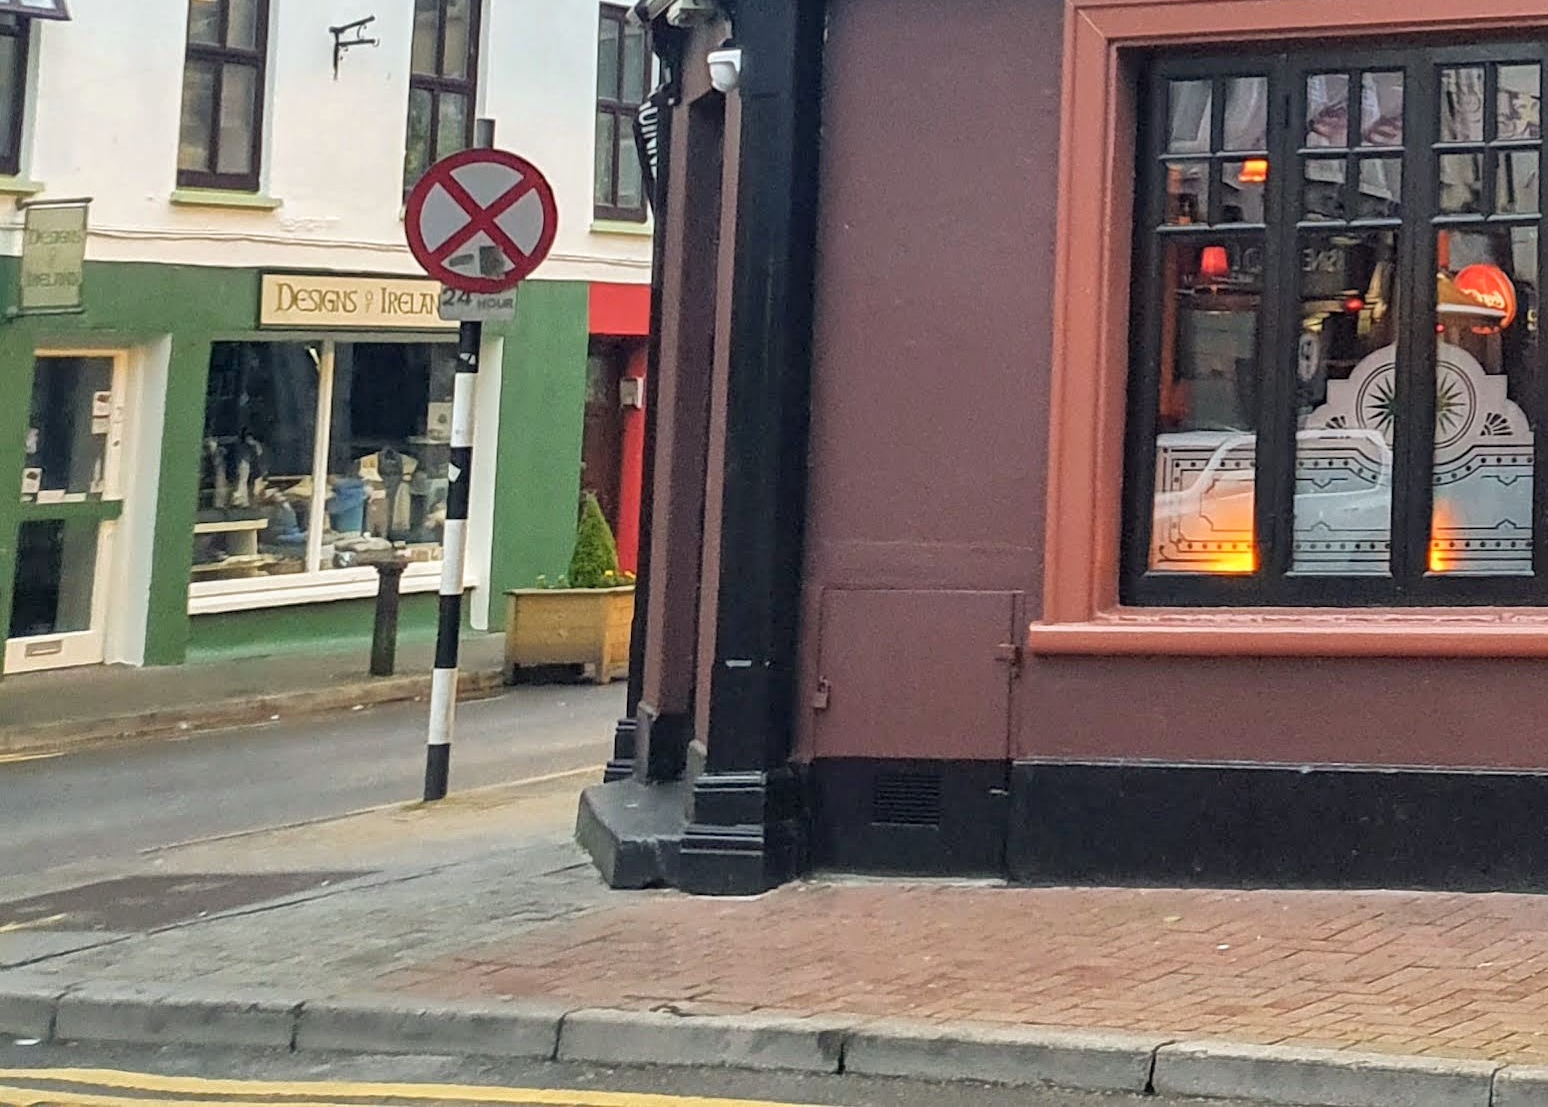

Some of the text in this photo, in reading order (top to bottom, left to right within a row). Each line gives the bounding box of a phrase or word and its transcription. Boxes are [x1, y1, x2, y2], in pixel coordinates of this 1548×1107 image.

[275, 282, 357, 314] DESIGNS
[380, 286, 439, 315] IRELAN
[477, 298, 513, 309] HOUR
